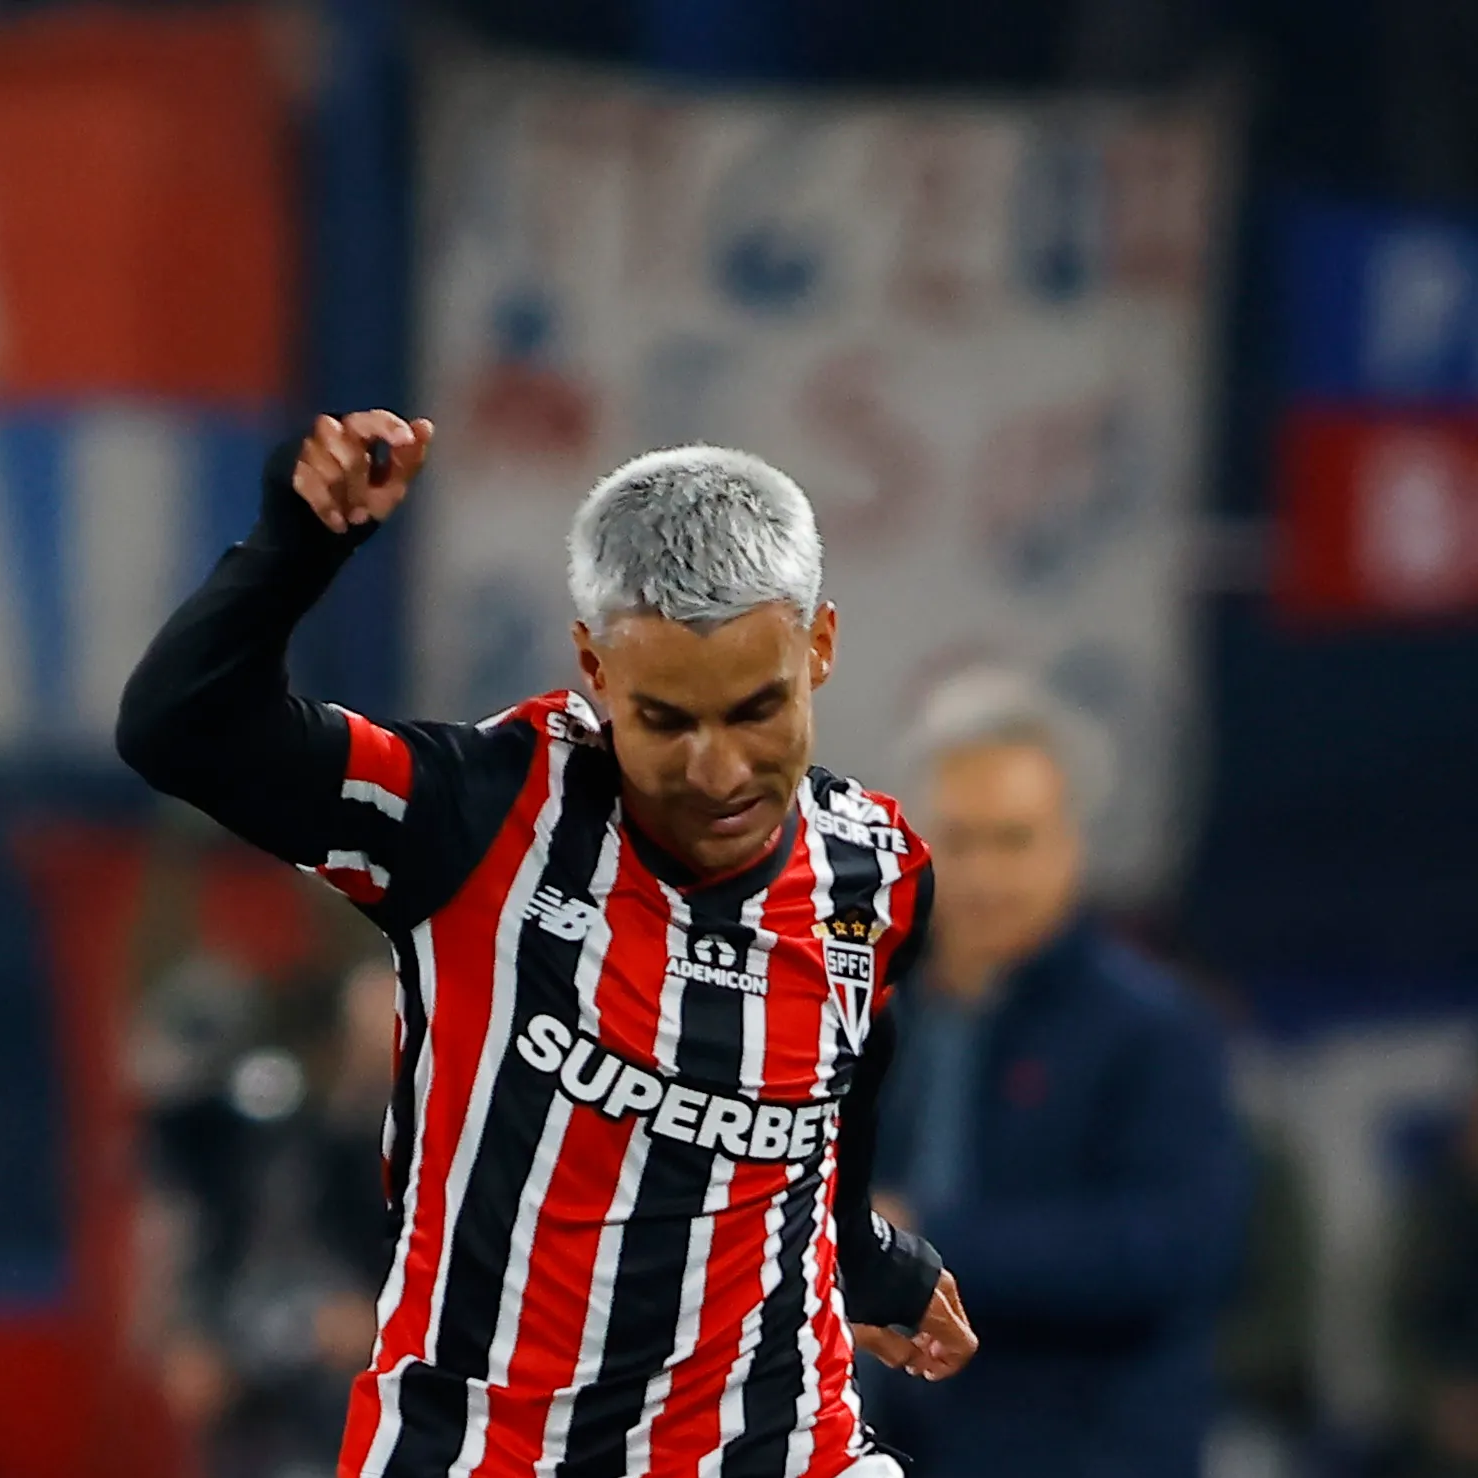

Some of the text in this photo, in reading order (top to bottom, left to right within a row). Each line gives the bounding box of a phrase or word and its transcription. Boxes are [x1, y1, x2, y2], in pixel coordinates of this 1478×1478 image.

[815, 809, 910, 855] SORTE
[665, 956, 769, 997] ADEMICON
[827, 949, 871, 981] SPFC
